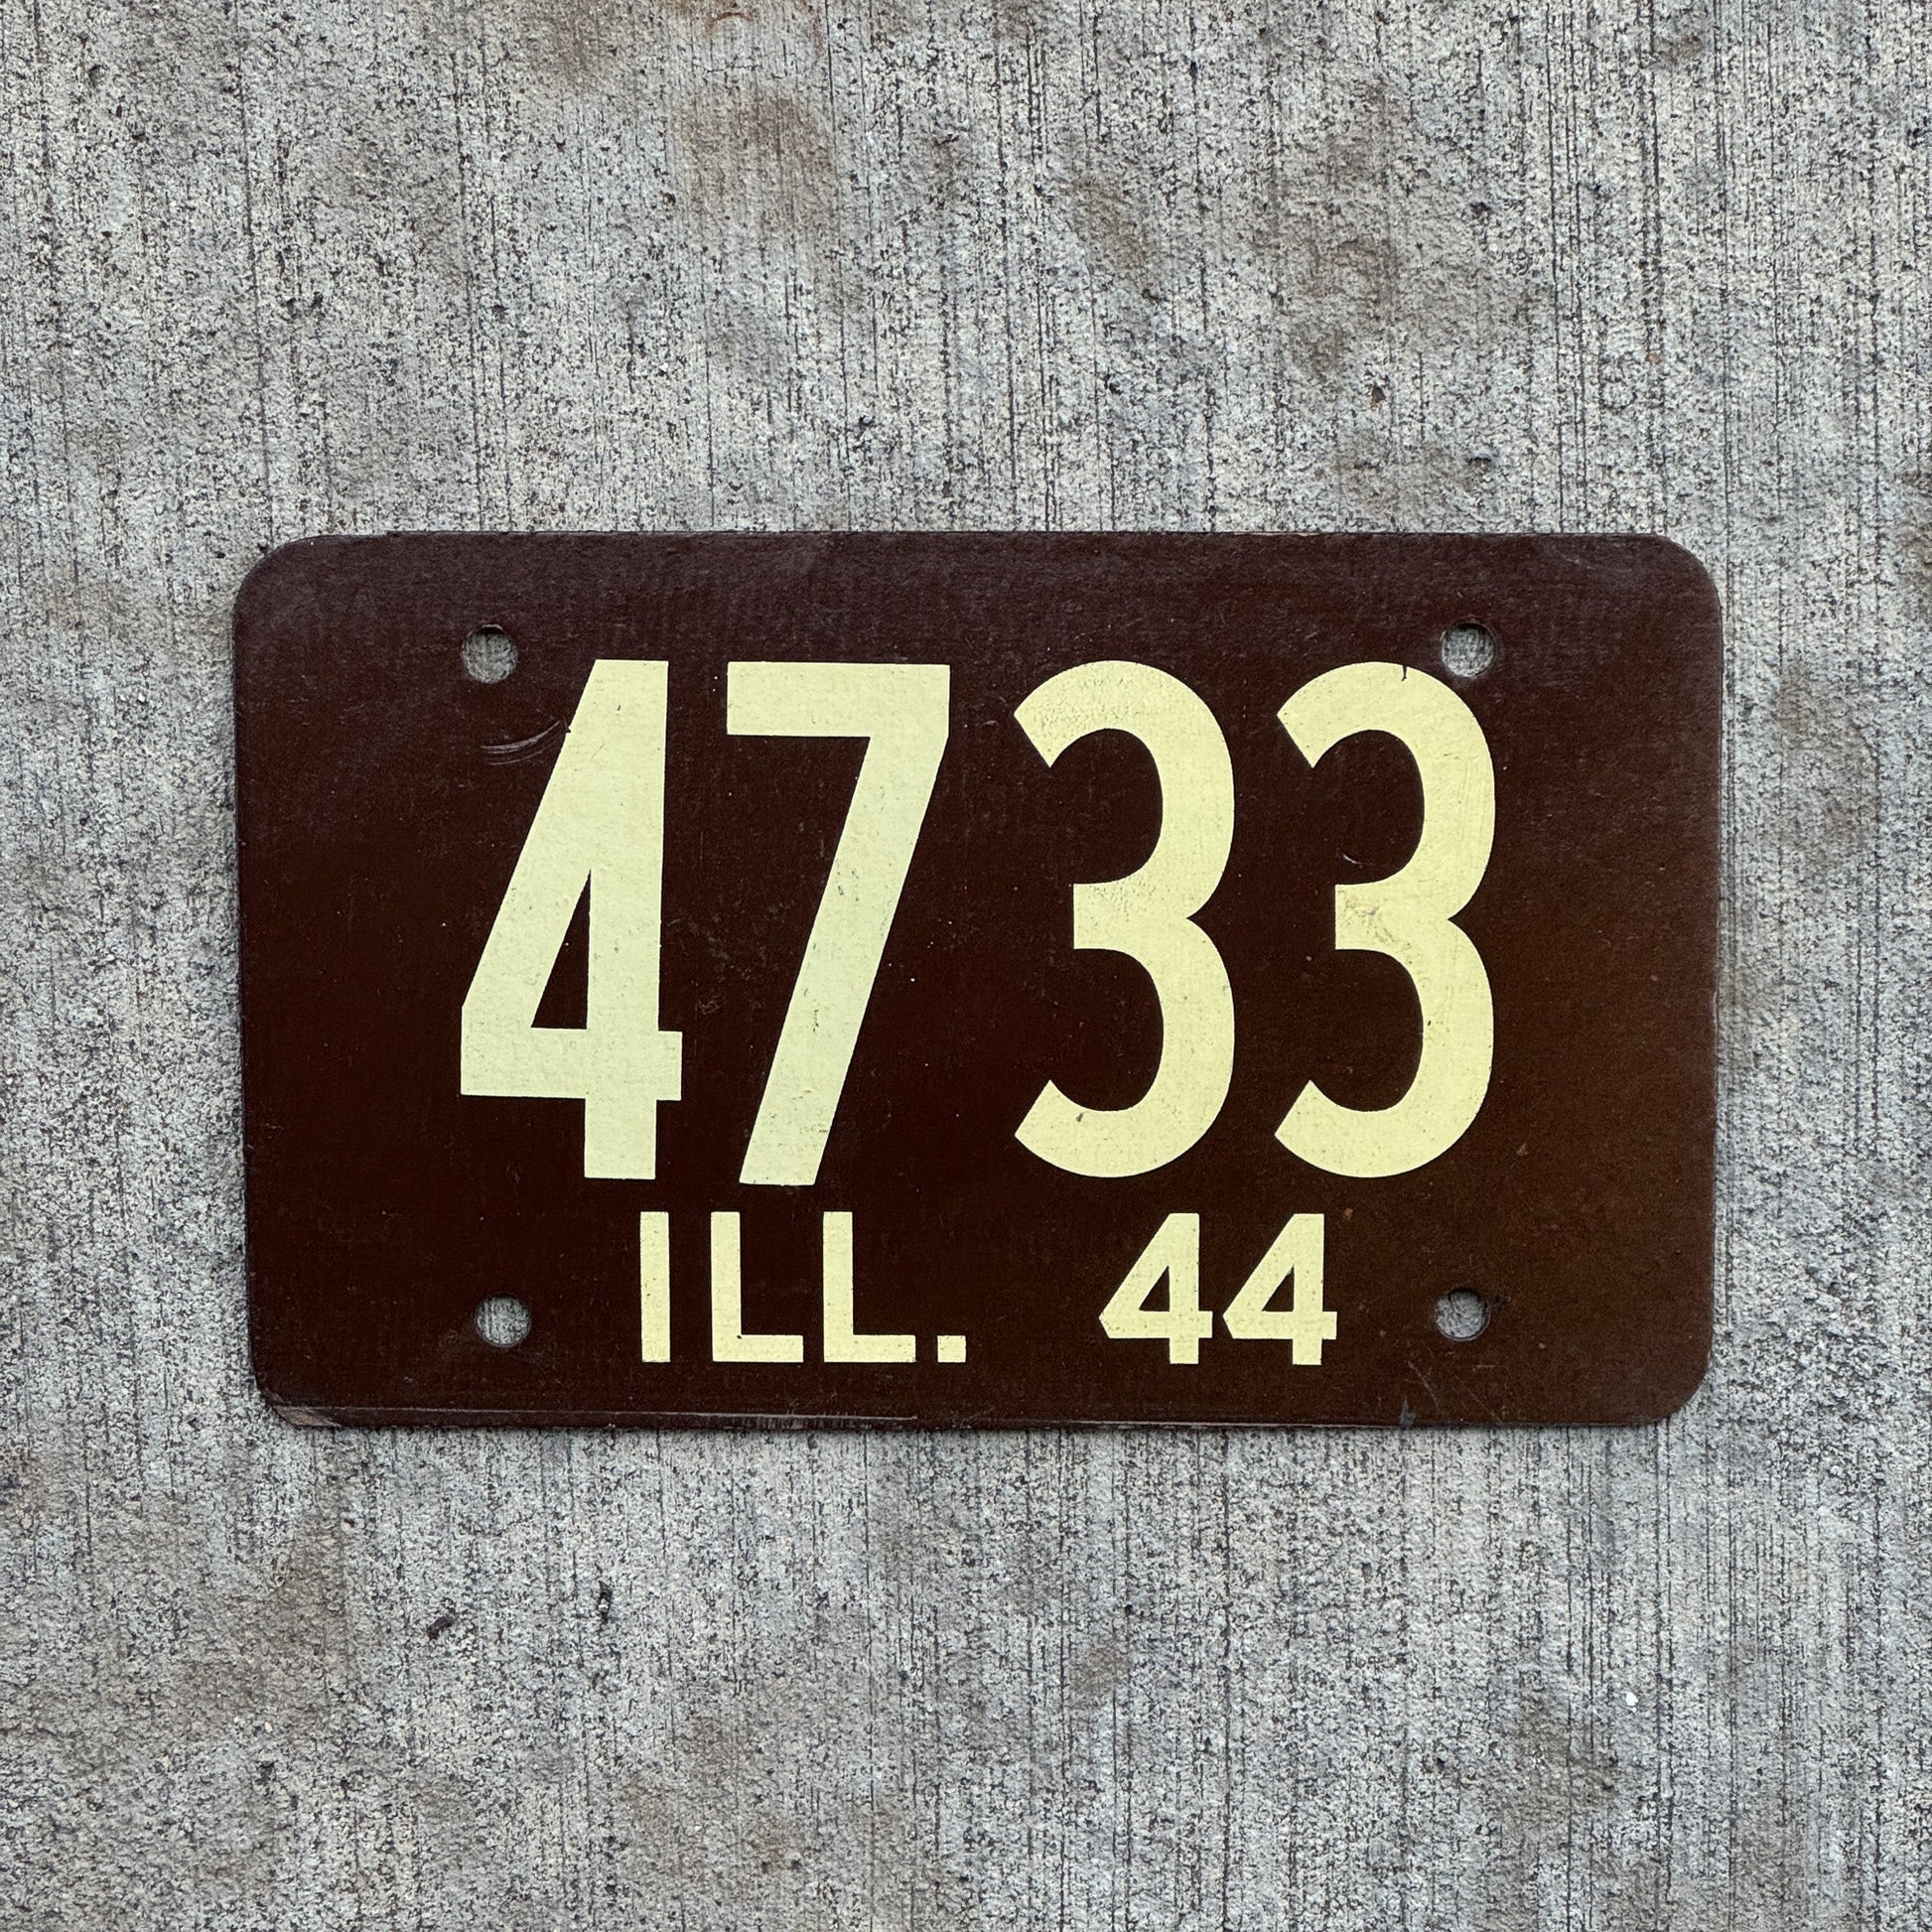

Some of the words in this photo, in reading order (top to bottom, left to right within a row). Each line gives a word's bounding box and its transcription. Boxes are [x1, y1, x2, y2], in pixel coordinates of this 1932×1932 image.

[460, 659, 1496, 1185] 4733
[639, 1211, 967, 1363] ILL.
[1098, 1212, 1338, 1366] 44
